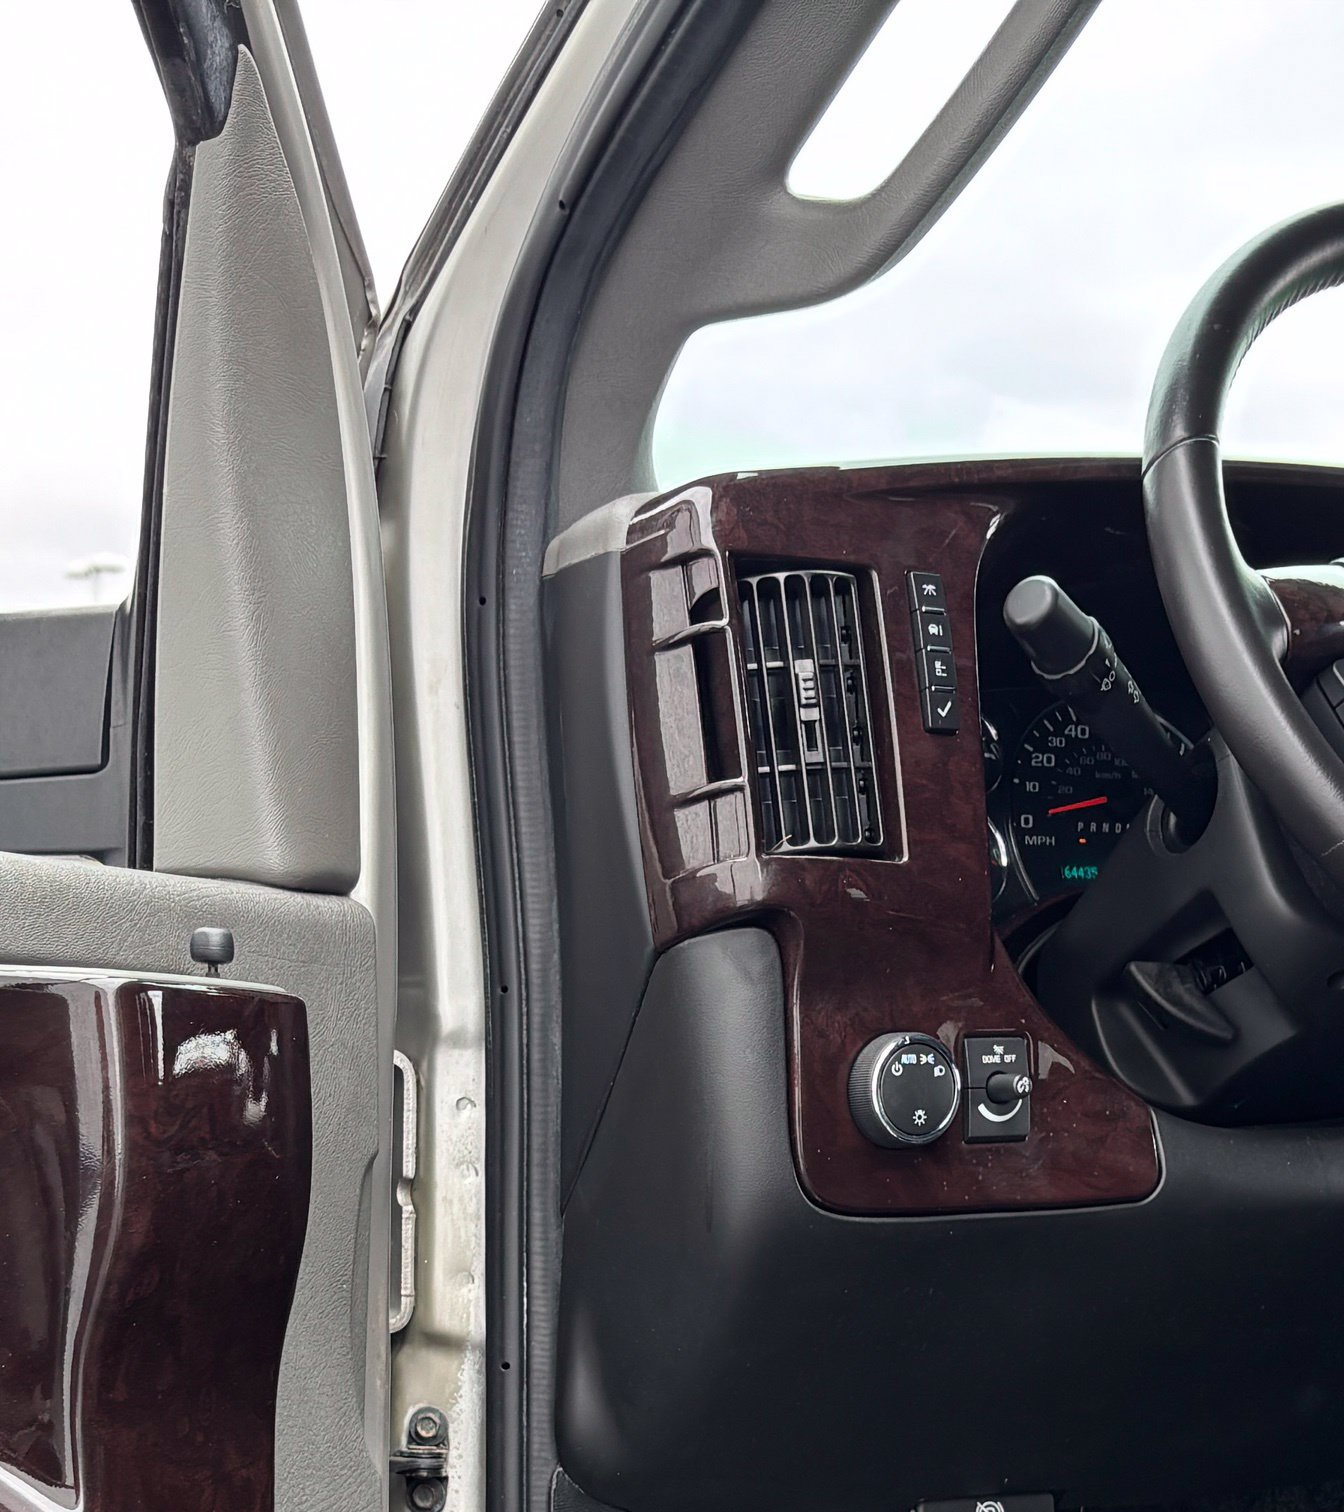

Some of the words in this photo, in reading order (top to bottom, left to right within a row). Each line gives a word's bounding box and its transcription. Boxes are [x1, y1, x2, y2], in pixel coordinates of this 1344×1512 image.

[1064, 724, 1090, 739] 40
[1047, 736, 1066, 748] 30
[1031, 753, 1056, 767] 20
[1025, 781, 1039, 793] 10
[1020, 814, 1034, 828] 0
[1024, 835, 1056, 846] MPH
[981, 1054, 1002, 1064] DOME
[1003, 1054, 1017, 1063] OFF
